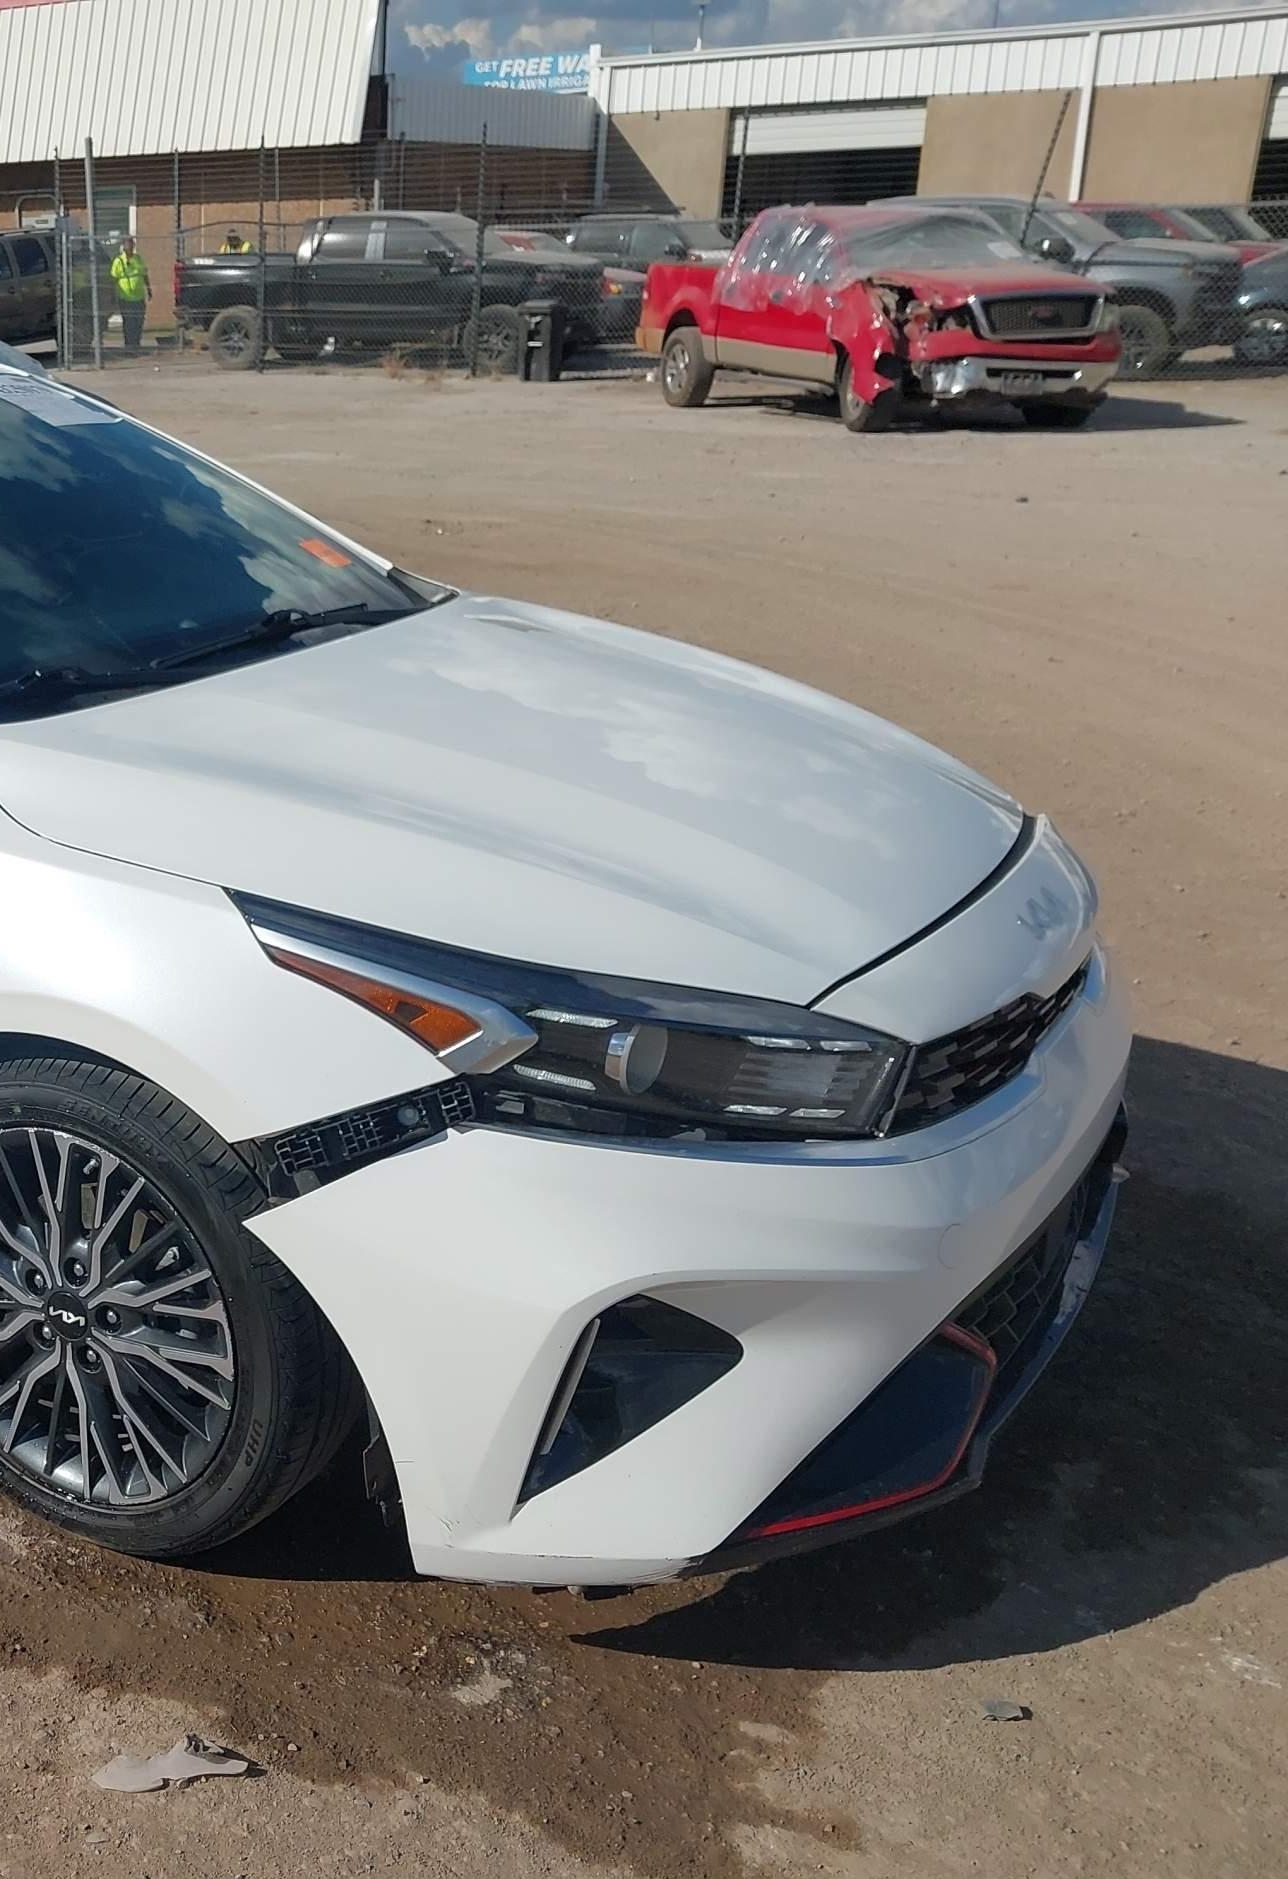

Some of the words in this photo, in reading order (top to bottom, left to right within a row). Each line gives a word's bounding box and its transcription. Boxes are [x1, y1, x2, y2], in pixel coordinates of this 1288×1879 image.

[475, 62, 499, 73] GET
[499, 57, 554, 77] FREE
[510, 77, 547, 90] LAWN
[244, 1418, 263, 1467] UHP
